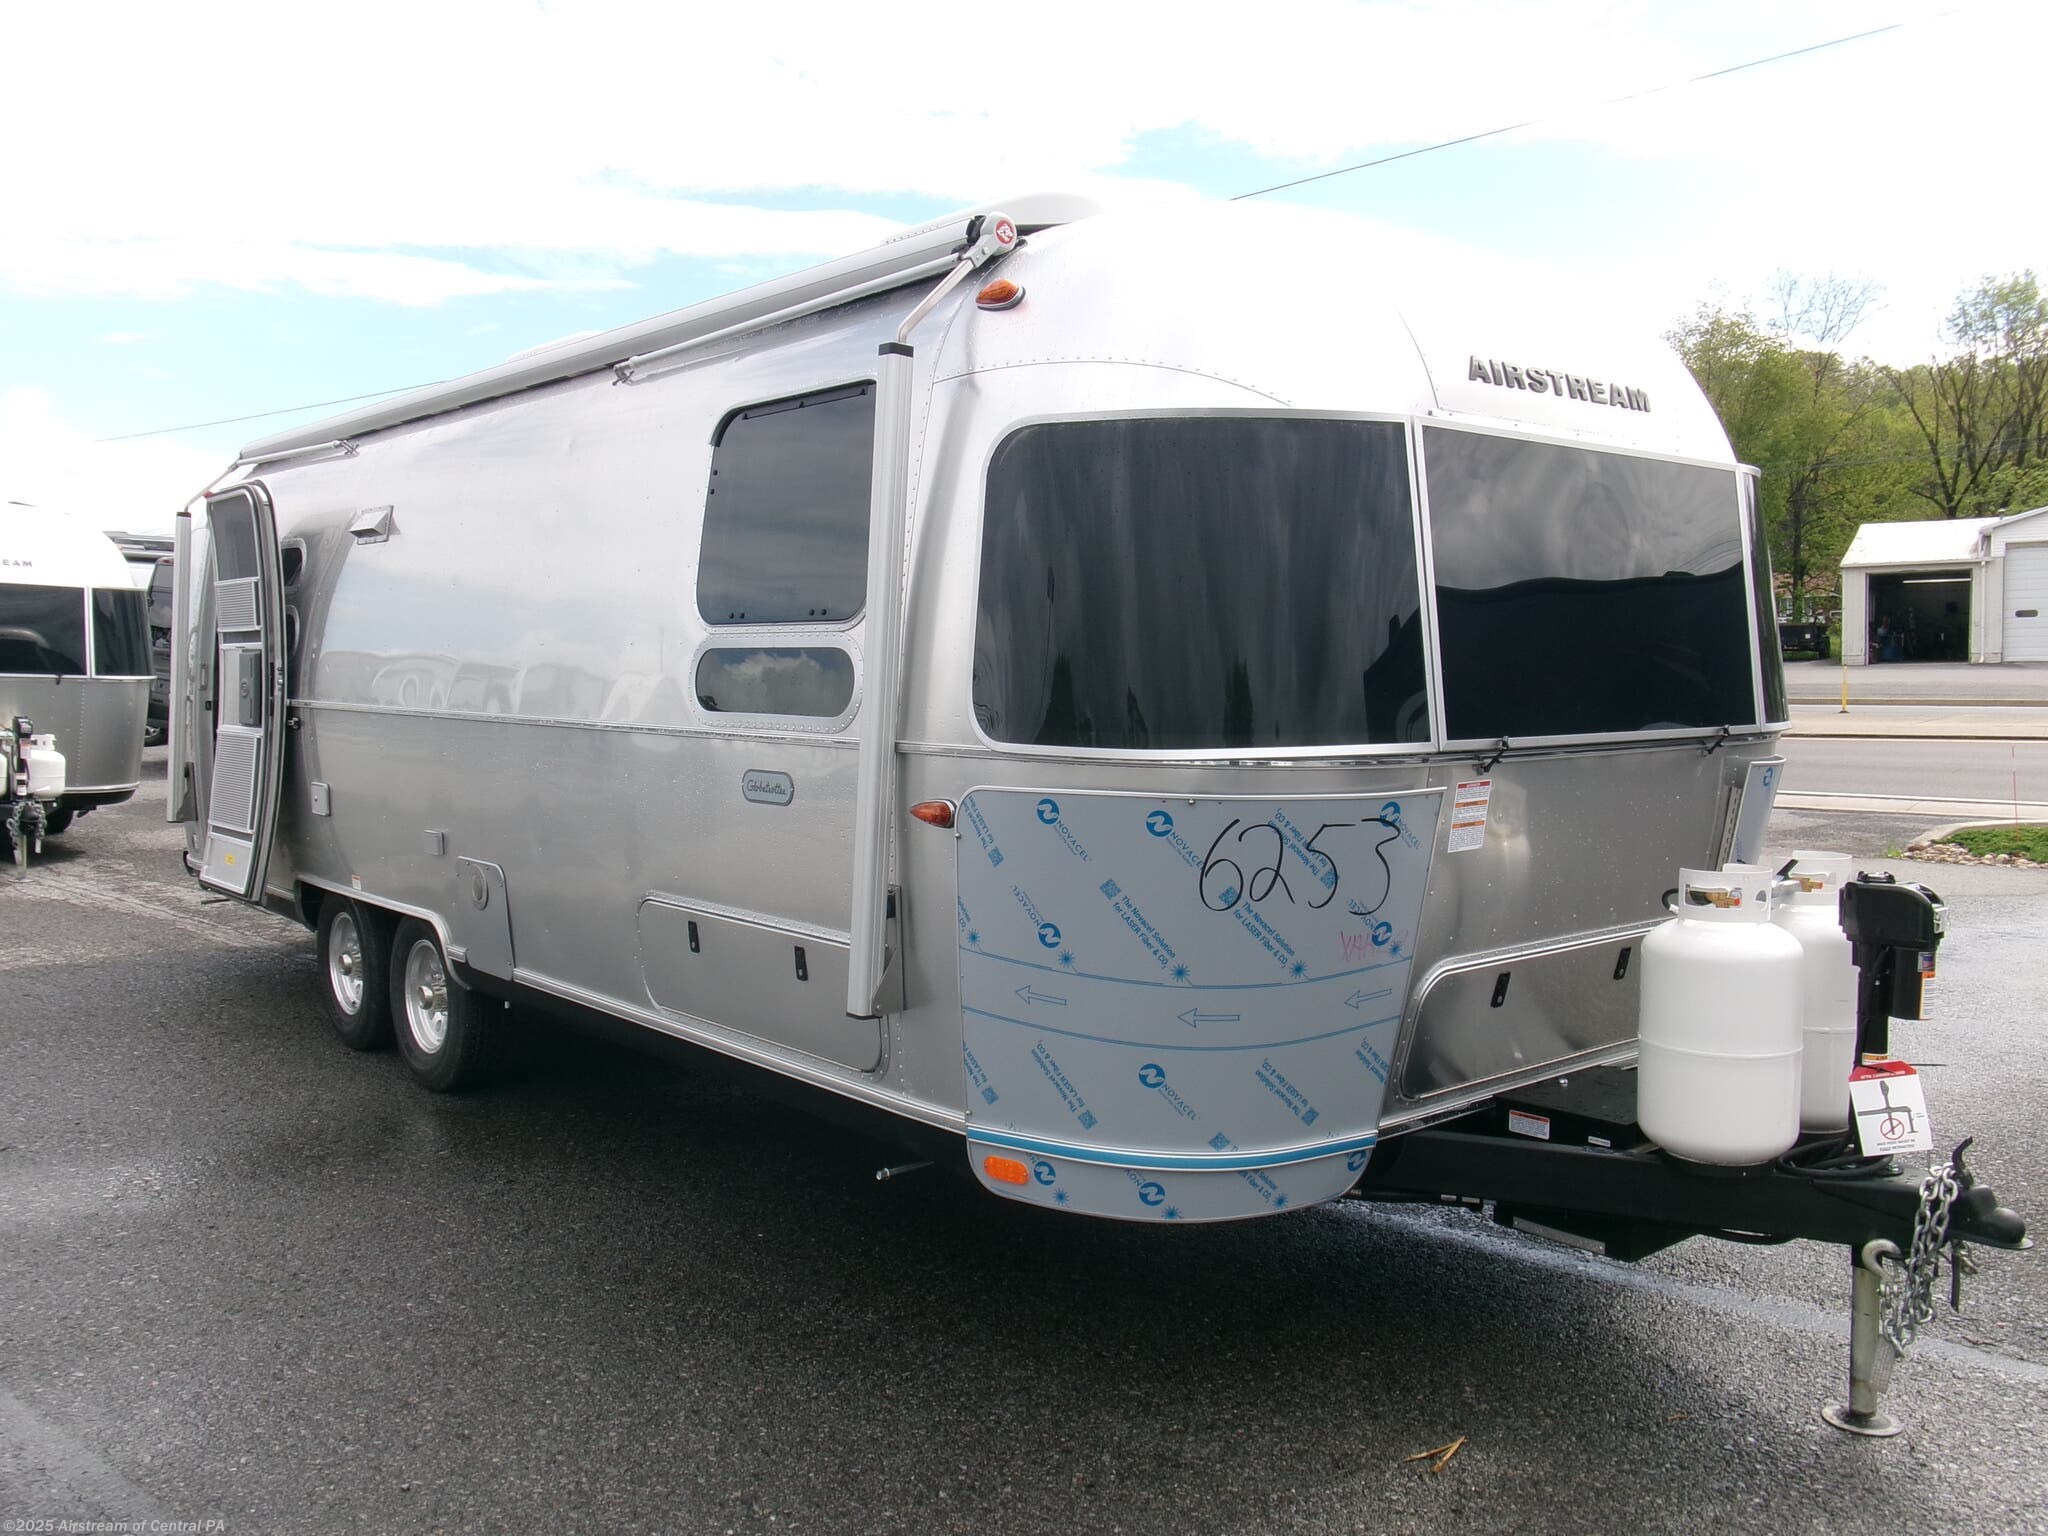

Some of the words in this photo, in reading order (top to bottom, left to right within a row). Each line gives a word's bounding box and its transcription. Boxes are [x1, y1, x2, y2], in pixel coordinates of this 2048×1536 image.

[1468, 355, 1651, 413] AIRSTREAM
[1056, 820, 1088, 862] NOVACEL
[1199, 818, 1401, 916] 6253
[1121, 912, 1142, 934] LASER
[1122, 896, 1133, 909] The
[1131, 907, 1155, 933] Novacel
[1152, 932, 1176, 958] Solution
[1161, 1083, 1198, 1120] NOVACEL
